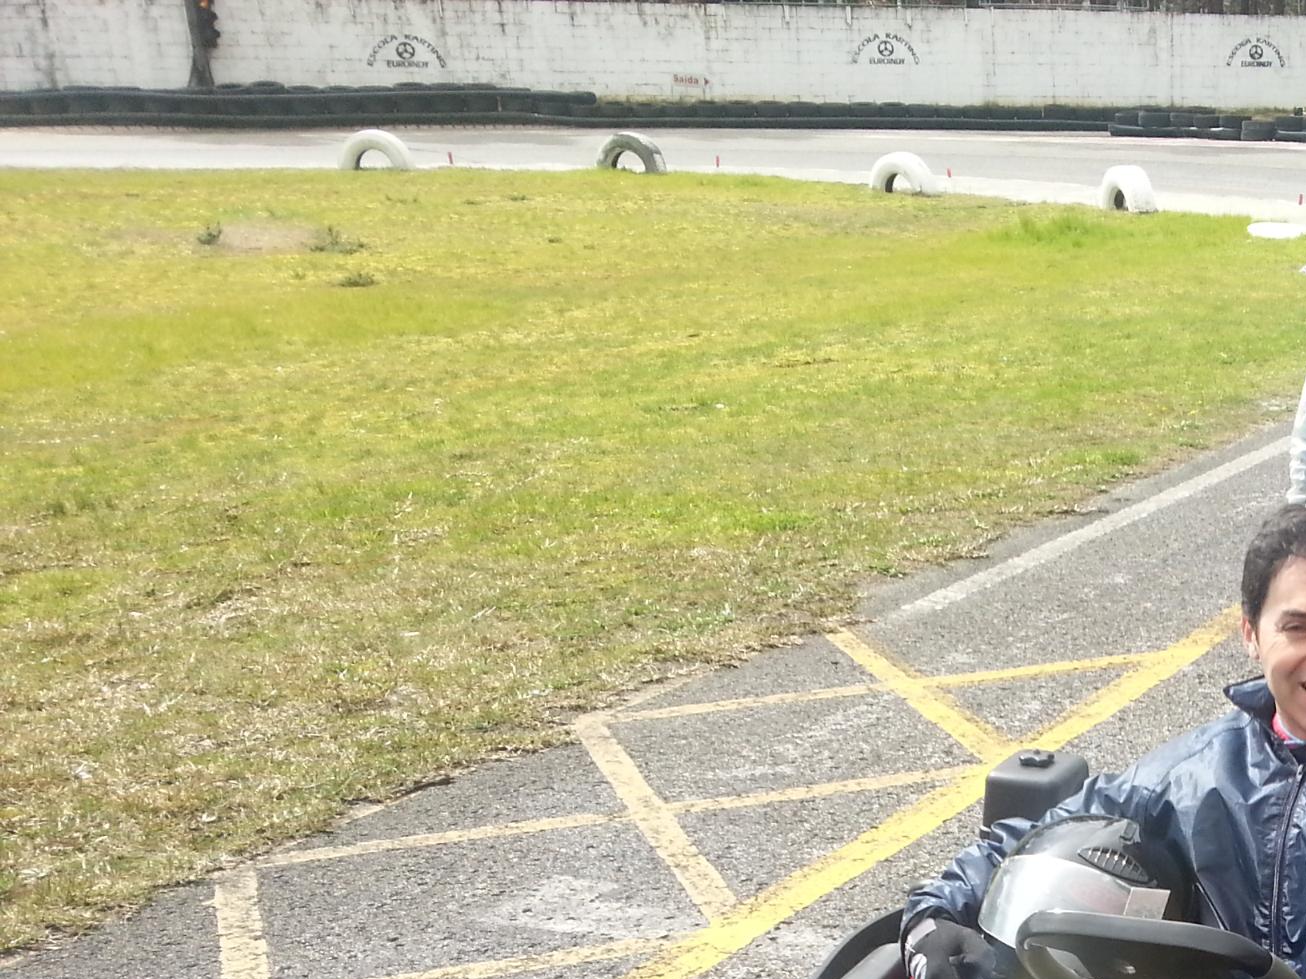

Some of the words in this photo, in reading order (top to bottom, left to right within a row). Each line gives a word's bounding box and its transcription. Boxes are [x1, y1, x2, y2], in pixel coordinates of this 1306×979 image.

[367, 34, 398, 67] ESCOLA
[404, 34, 446, 68] KARTING
[852, 33, 880, 64] ESCOLA
[885, 33, 920, 65] KARTING
[1226, 38, 1251, 66] ESCOLA
[1256, 38, 1286, 67] KARTING
